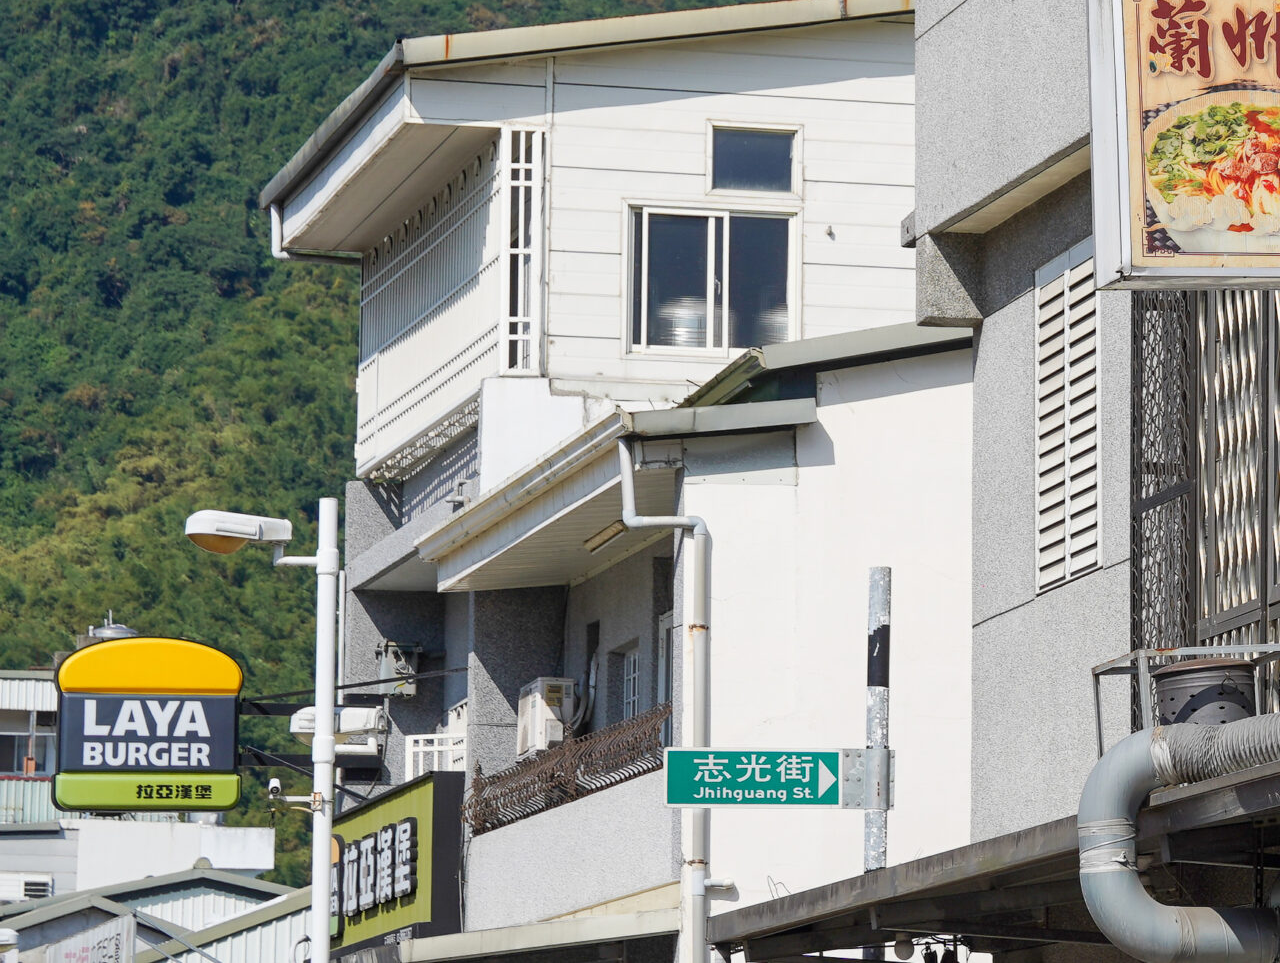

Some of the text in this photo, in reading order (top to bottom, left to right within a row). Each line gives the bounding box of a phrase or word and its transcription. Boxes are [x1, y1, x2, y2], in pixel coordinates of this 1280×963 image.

[83, 699, 211, 737] LAYA
[82, 741, 211, 767] BURGER
[693, 754, 815, 783] 志光街
[136, 784, 213, 799] 拉亞漢堡
[693, 786, 814, 802] Jhihguang St.
[342, 821, 412, 917] 拉亞漢堡
